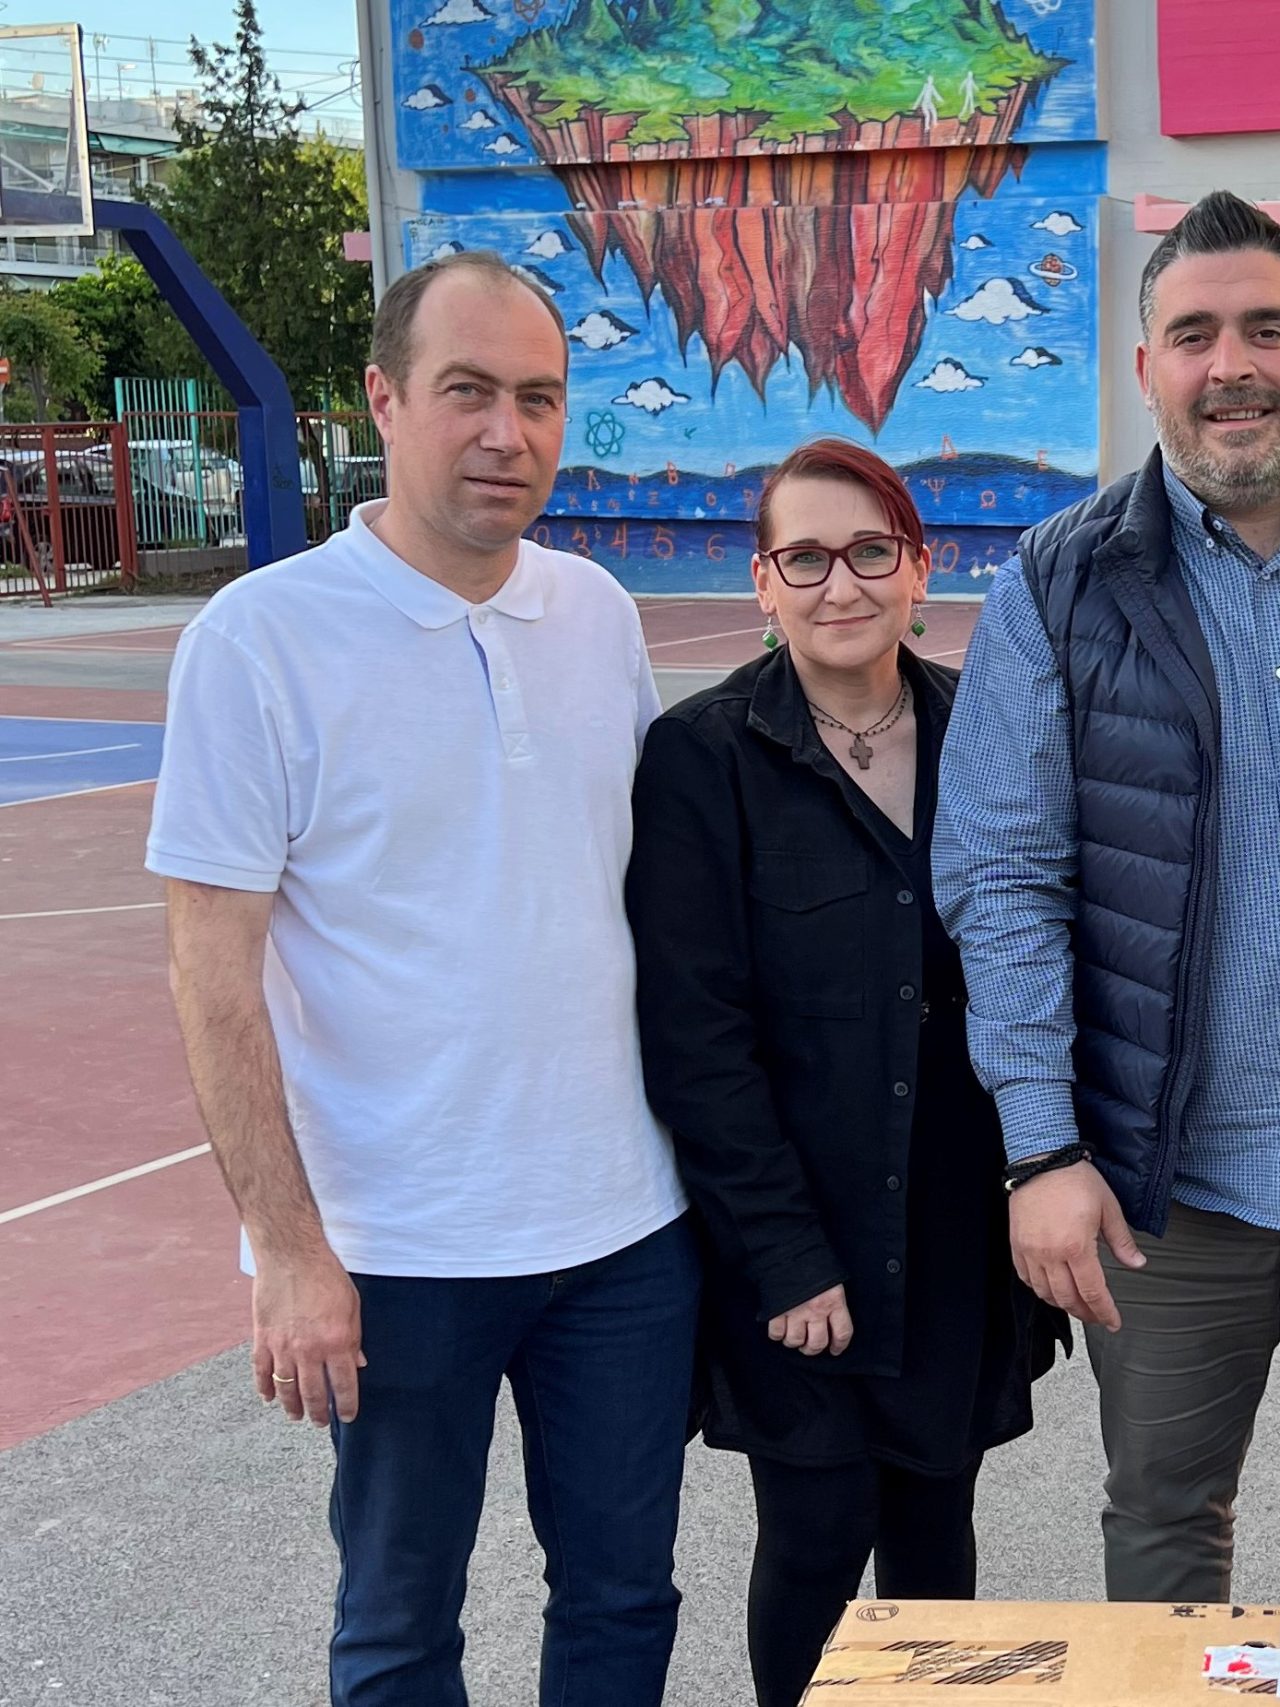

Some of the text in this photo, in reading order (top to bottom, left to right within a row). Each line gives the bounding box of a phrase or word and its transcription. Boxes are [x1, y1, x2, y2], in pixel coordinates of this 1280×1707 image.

[940, 433, 959, 461] Δ
[980, 490, 996, 510] Ω
[571, 525, 593, 559] 3
[609, 521, 628, 560] 4
[652, 524, 676, 560] 5
[707, 532, 726, 562] 6
